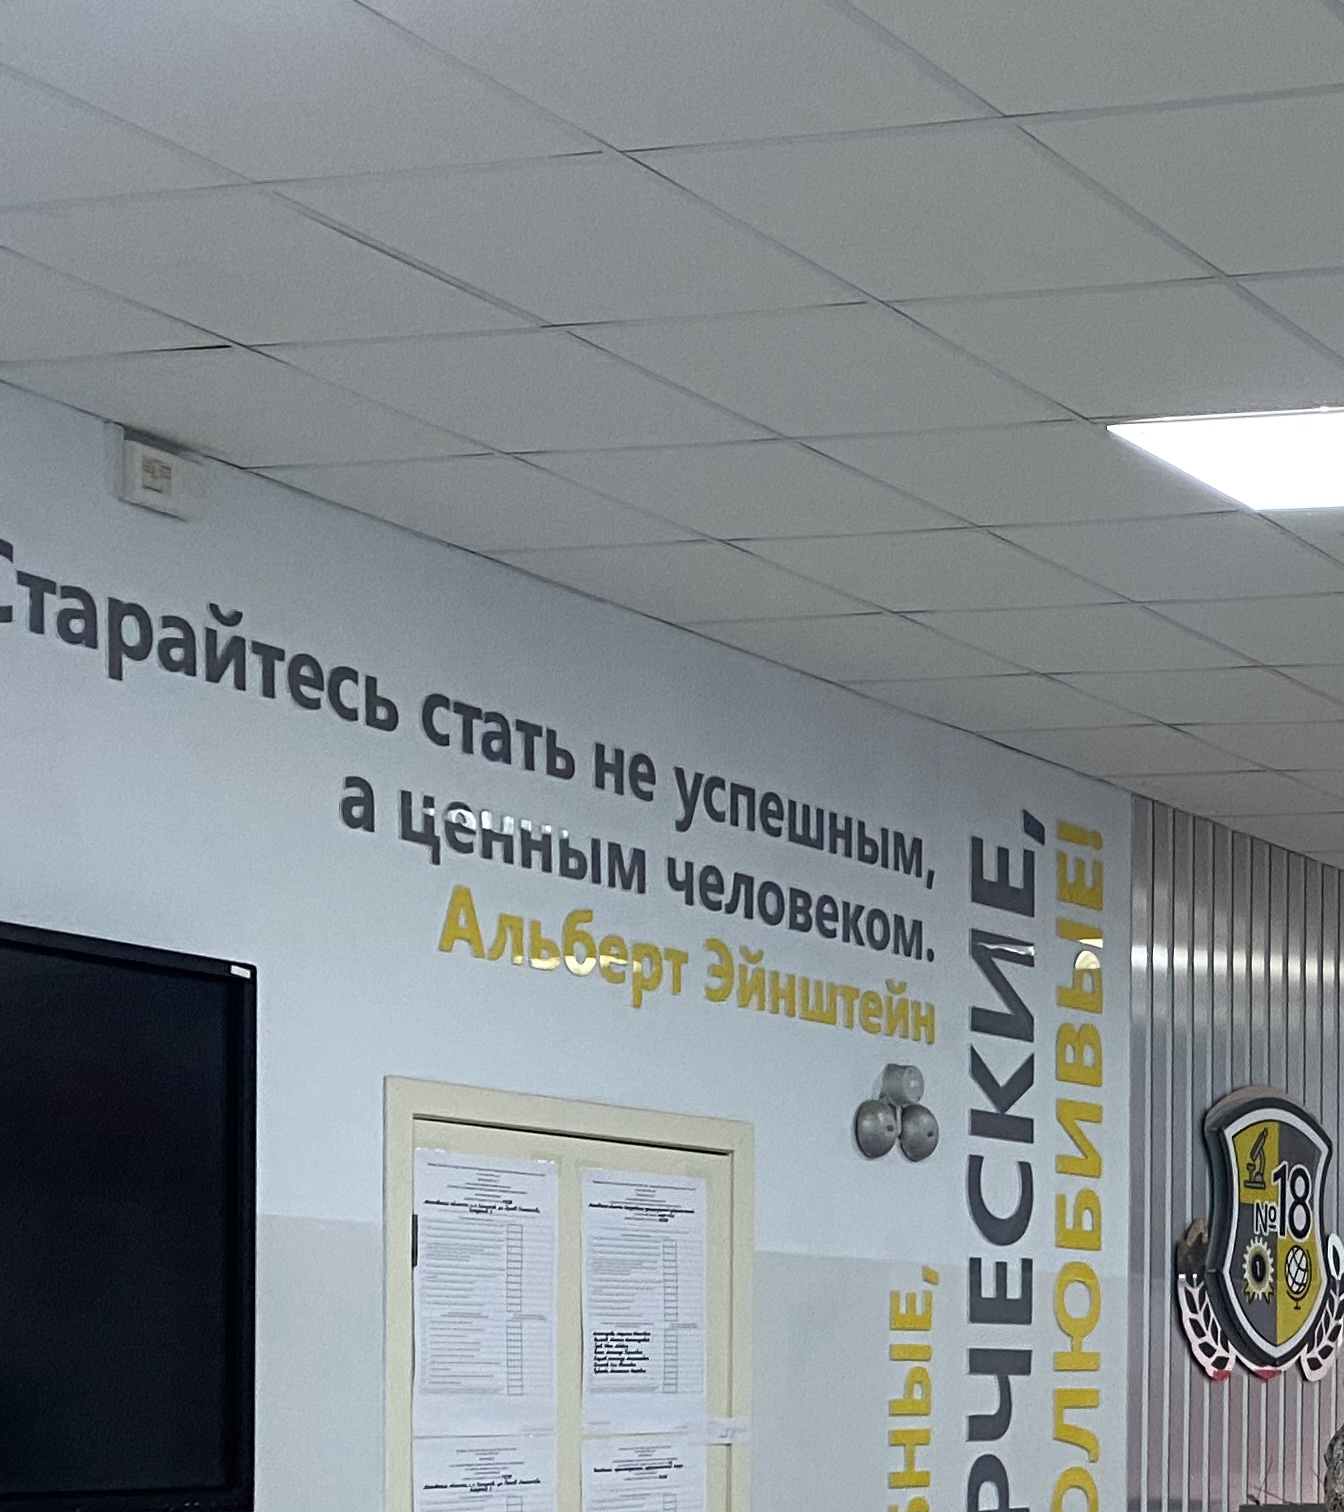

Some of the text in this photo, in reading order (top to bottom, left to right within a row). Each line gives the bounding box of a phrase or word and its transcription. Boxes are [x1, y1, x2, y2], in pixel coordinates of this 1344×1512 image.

[340, 776, 936, 963] а ценным человеком.
[420, 693, 576, 780] стать
[594, 742, 656, 802] не
[673, 766, 936, 890] успешным,
[438, 884, 936, 1045] Альберт Эйнштейн
